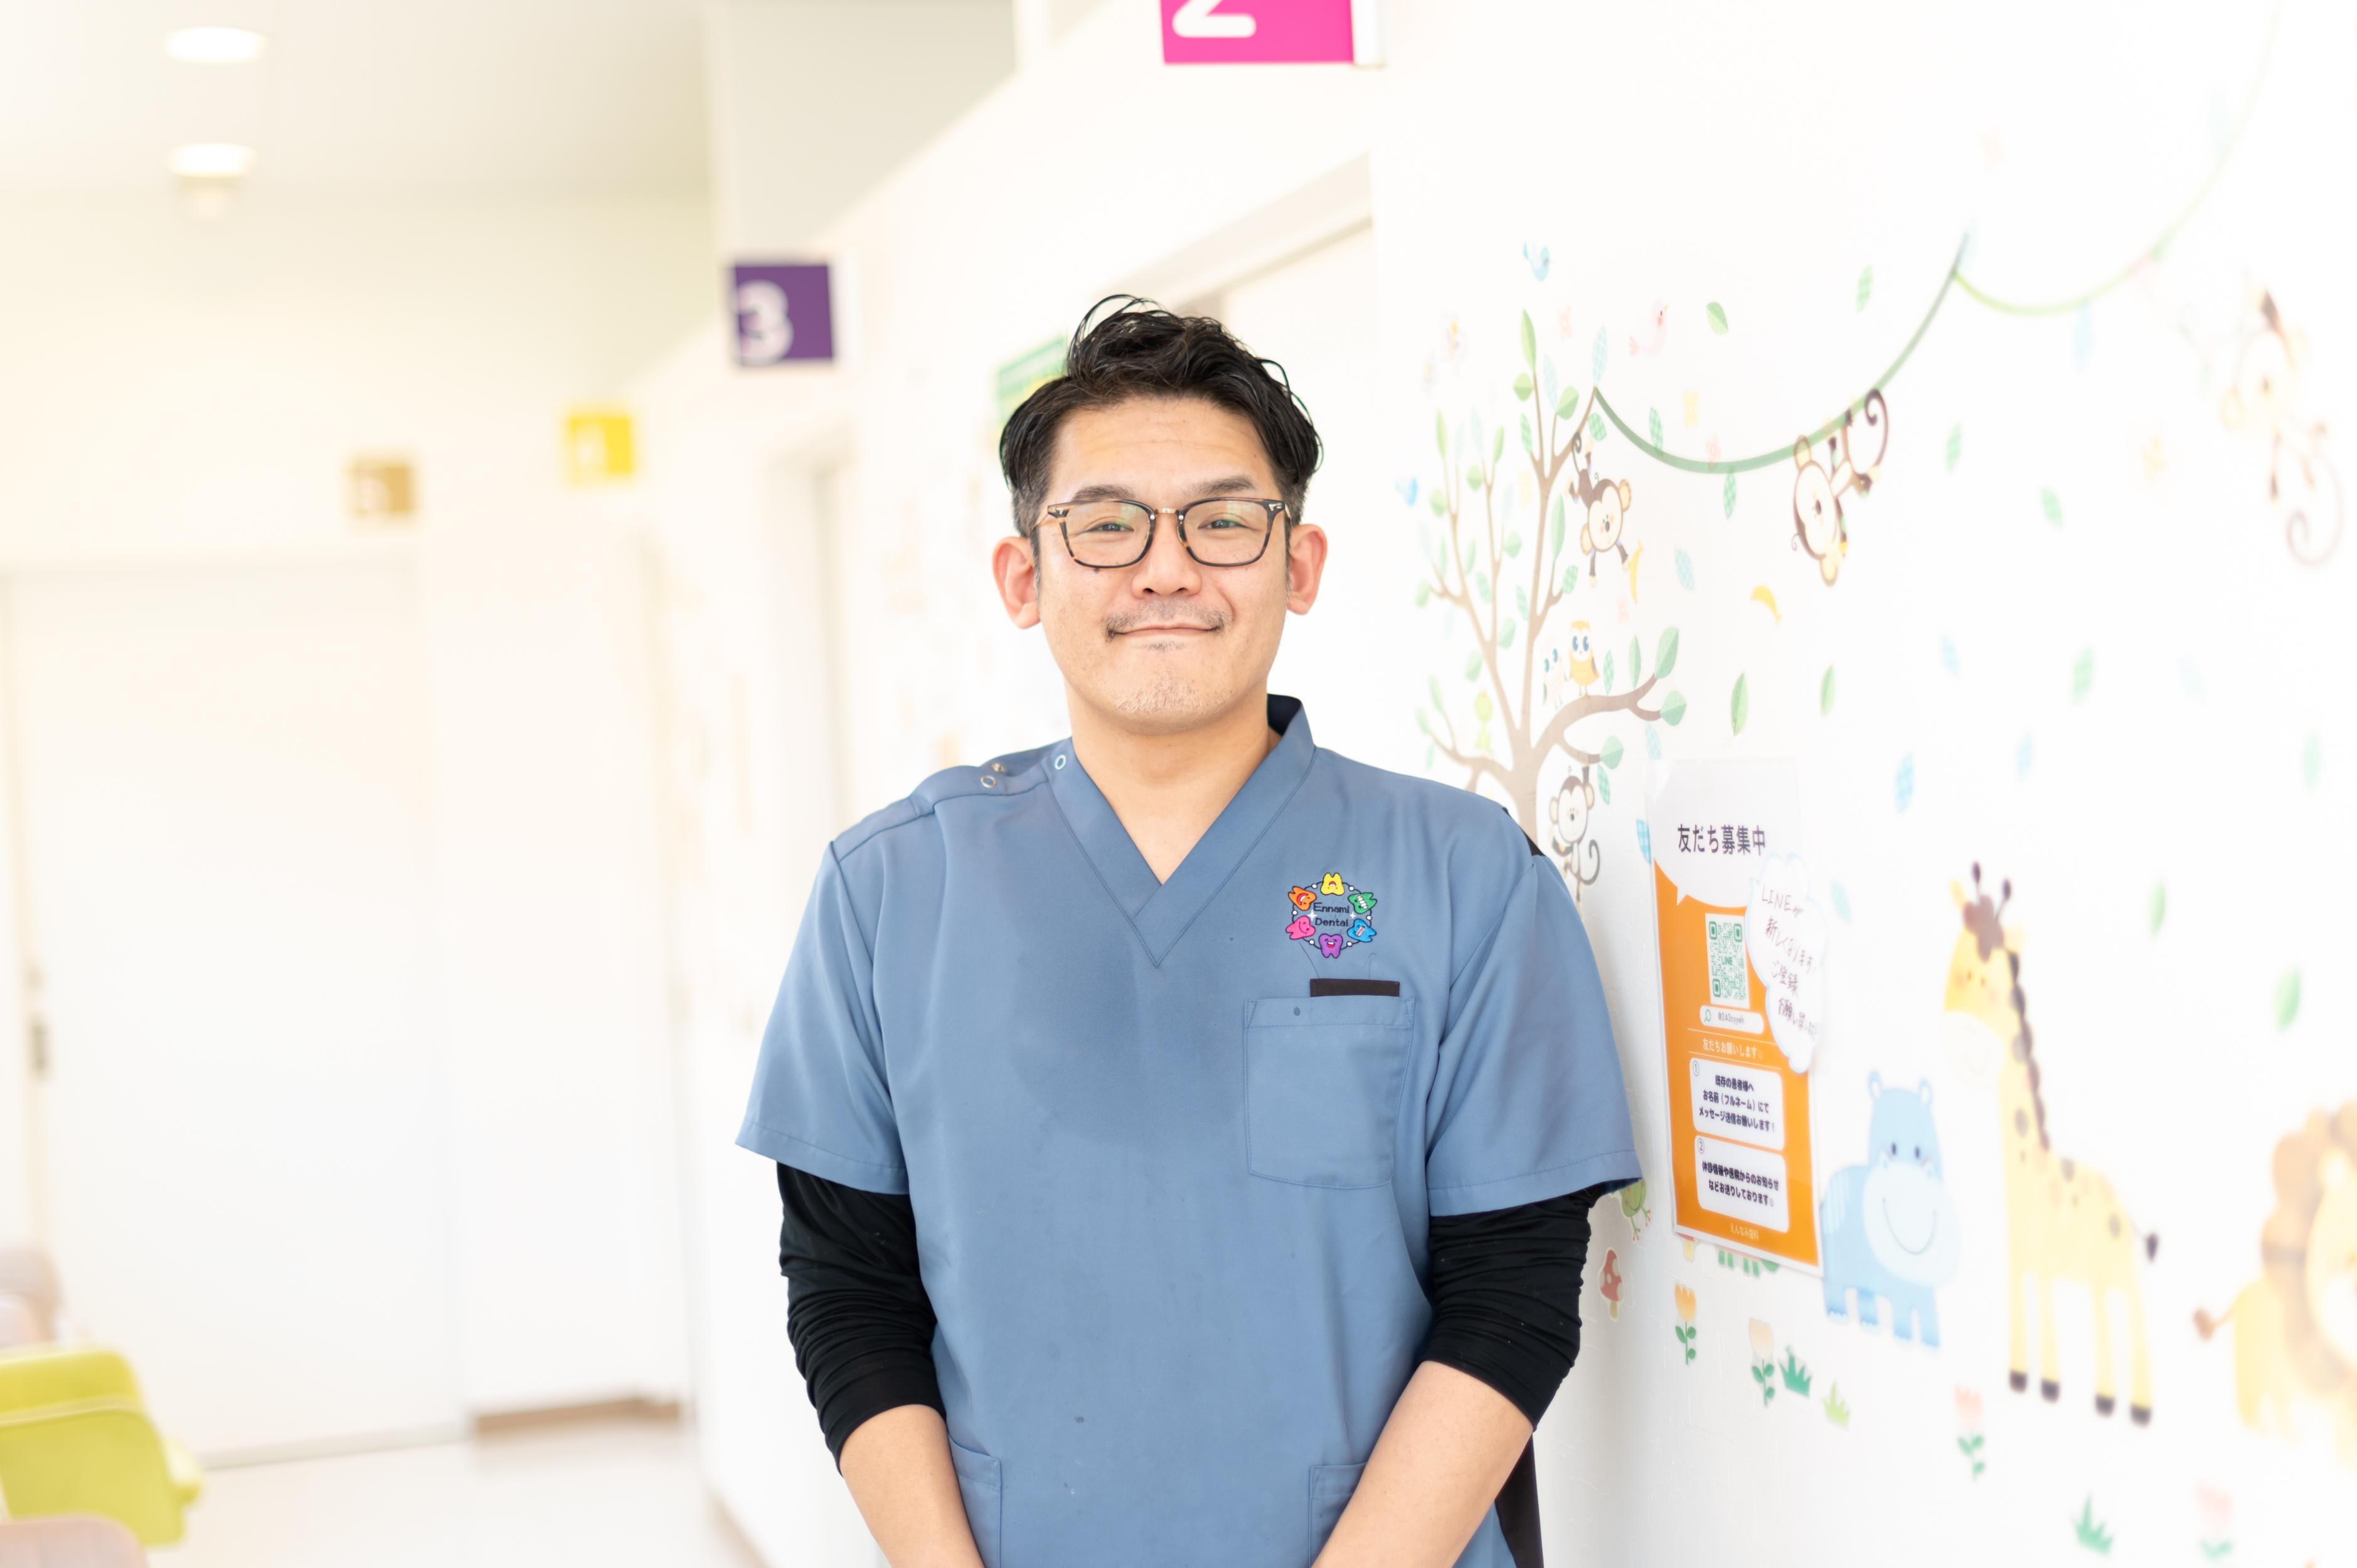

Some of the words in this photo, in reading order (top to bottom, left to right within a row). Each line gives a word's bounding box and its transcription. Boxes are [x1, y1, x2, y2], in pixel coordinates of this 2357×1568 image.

[730, 279, 795, 366] 3
[1677, 824, 1766, 856] 友だち募集中
[1313, 902, 1349, 913] Ennami
[1761, 884, 1804, 918] LINEが
[1315, 918, 1348, 927] Dental
[1721, 956, 1733, 966] LINE
[1715, 1074, 1755, 1093] 既存の患者様へ
